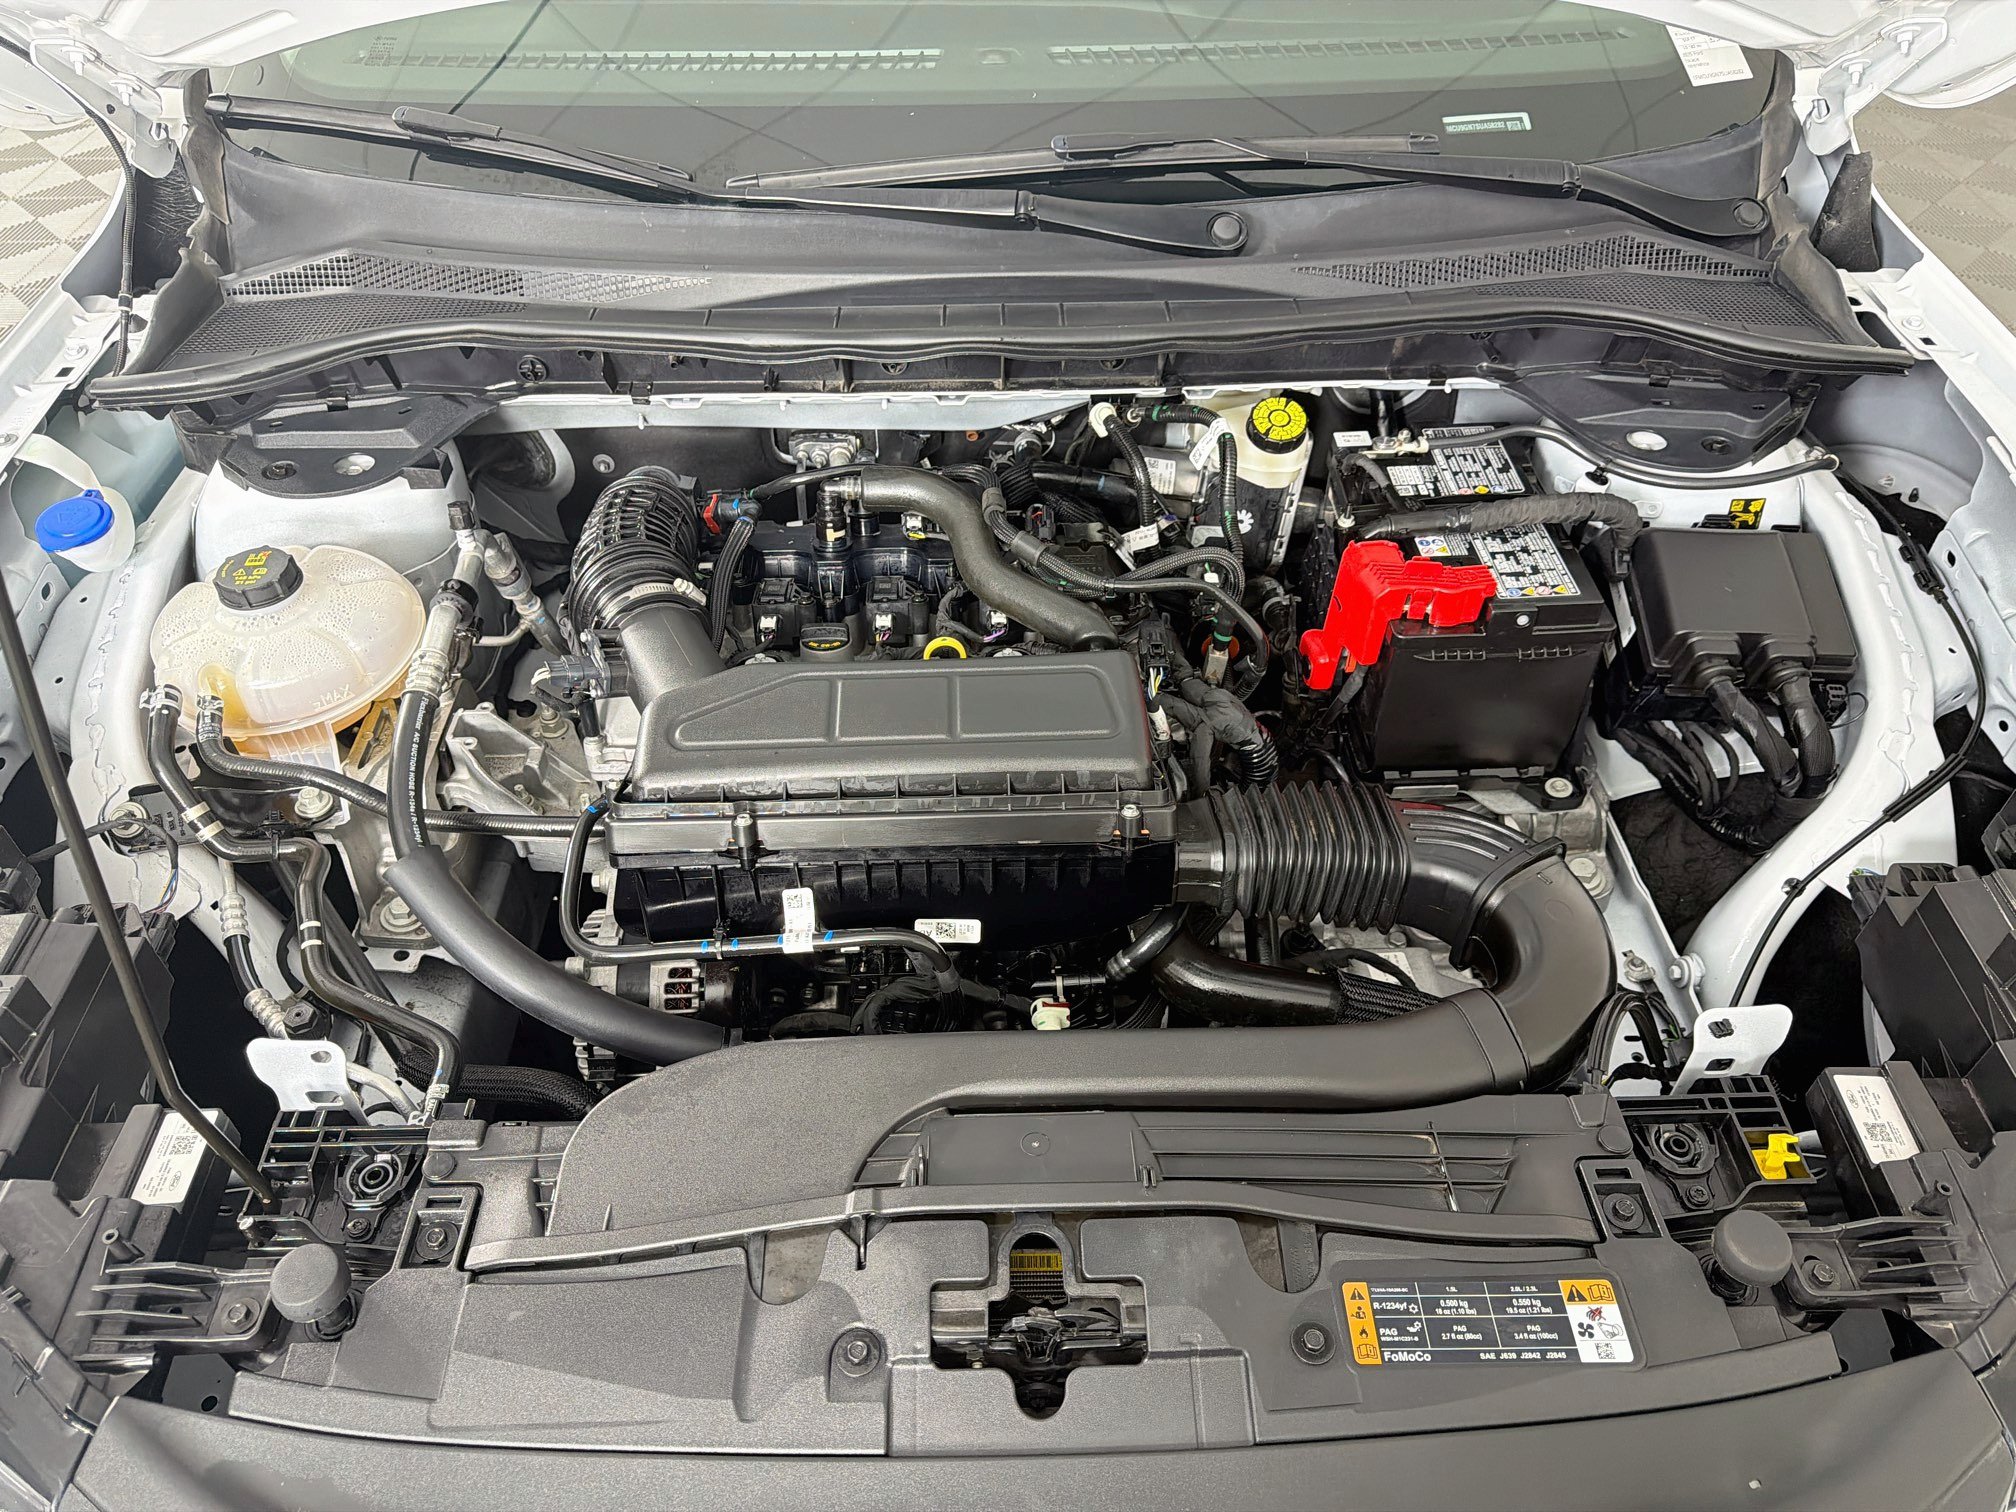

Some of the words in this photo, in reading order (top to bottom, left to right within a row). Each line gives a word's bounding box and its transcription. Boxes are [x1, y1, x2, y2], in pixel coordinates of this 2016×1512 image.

[410, 744, 419, 771] SUCTION
[1373, 1302, 1407, 1310] R-1234yf
[1459, 1300, 1468, 1308] kg
[1532, 1298, 1542, 1307] kg
[1384, 1352, 1432, 1362] FoMoCo
